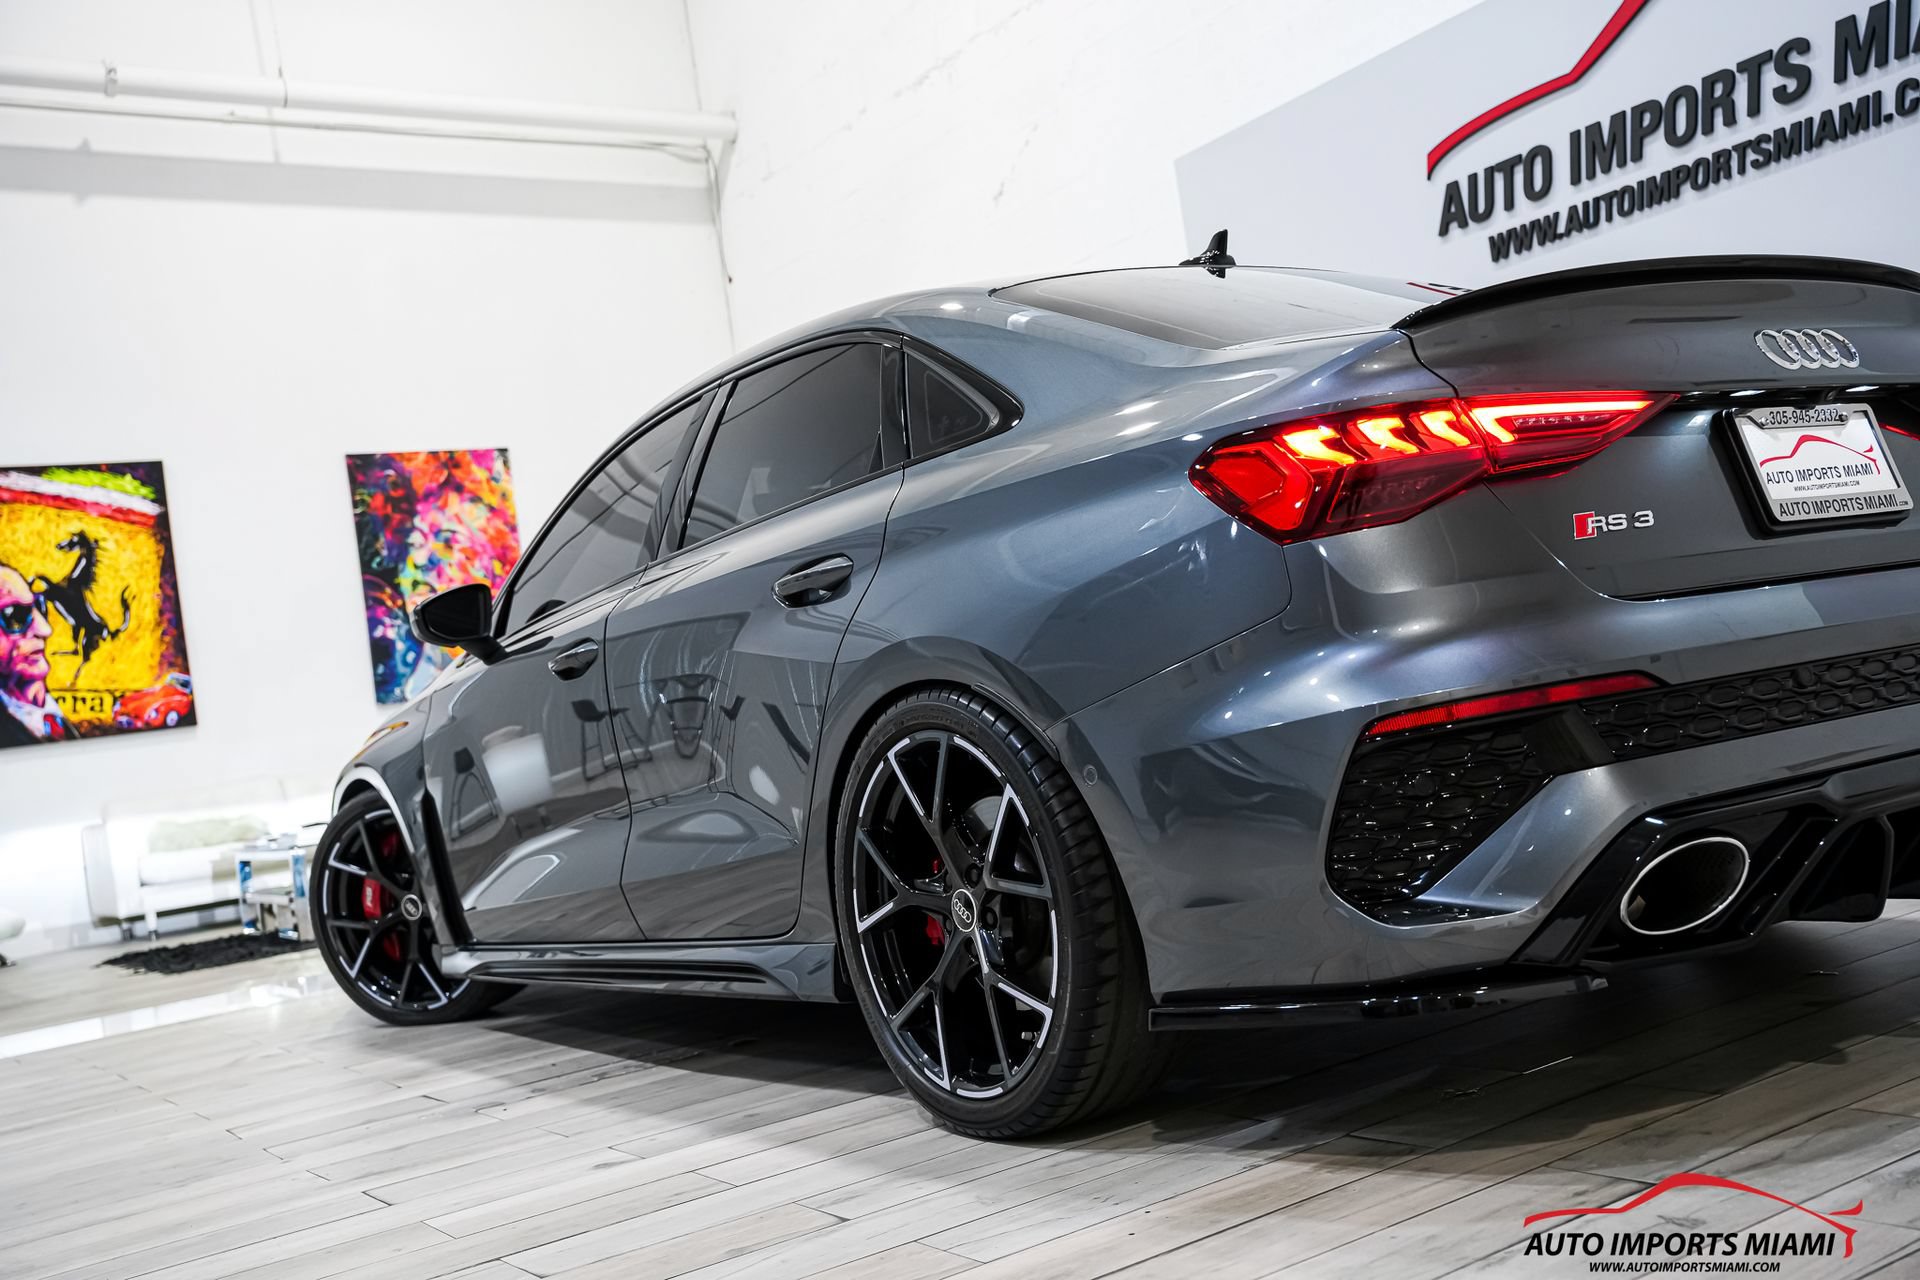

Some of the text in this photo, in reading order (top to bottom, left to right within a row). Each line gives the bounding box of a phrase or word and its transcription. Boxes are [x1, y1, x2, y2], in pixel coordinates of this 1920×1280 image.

[1439, 0, 1920, 237] AUTO IMPORTS MI
[1769, 408, 1840, 425] 305-945-2332
[1766, 462, 1874, 485] AUTO IMPORTS MIAMI
